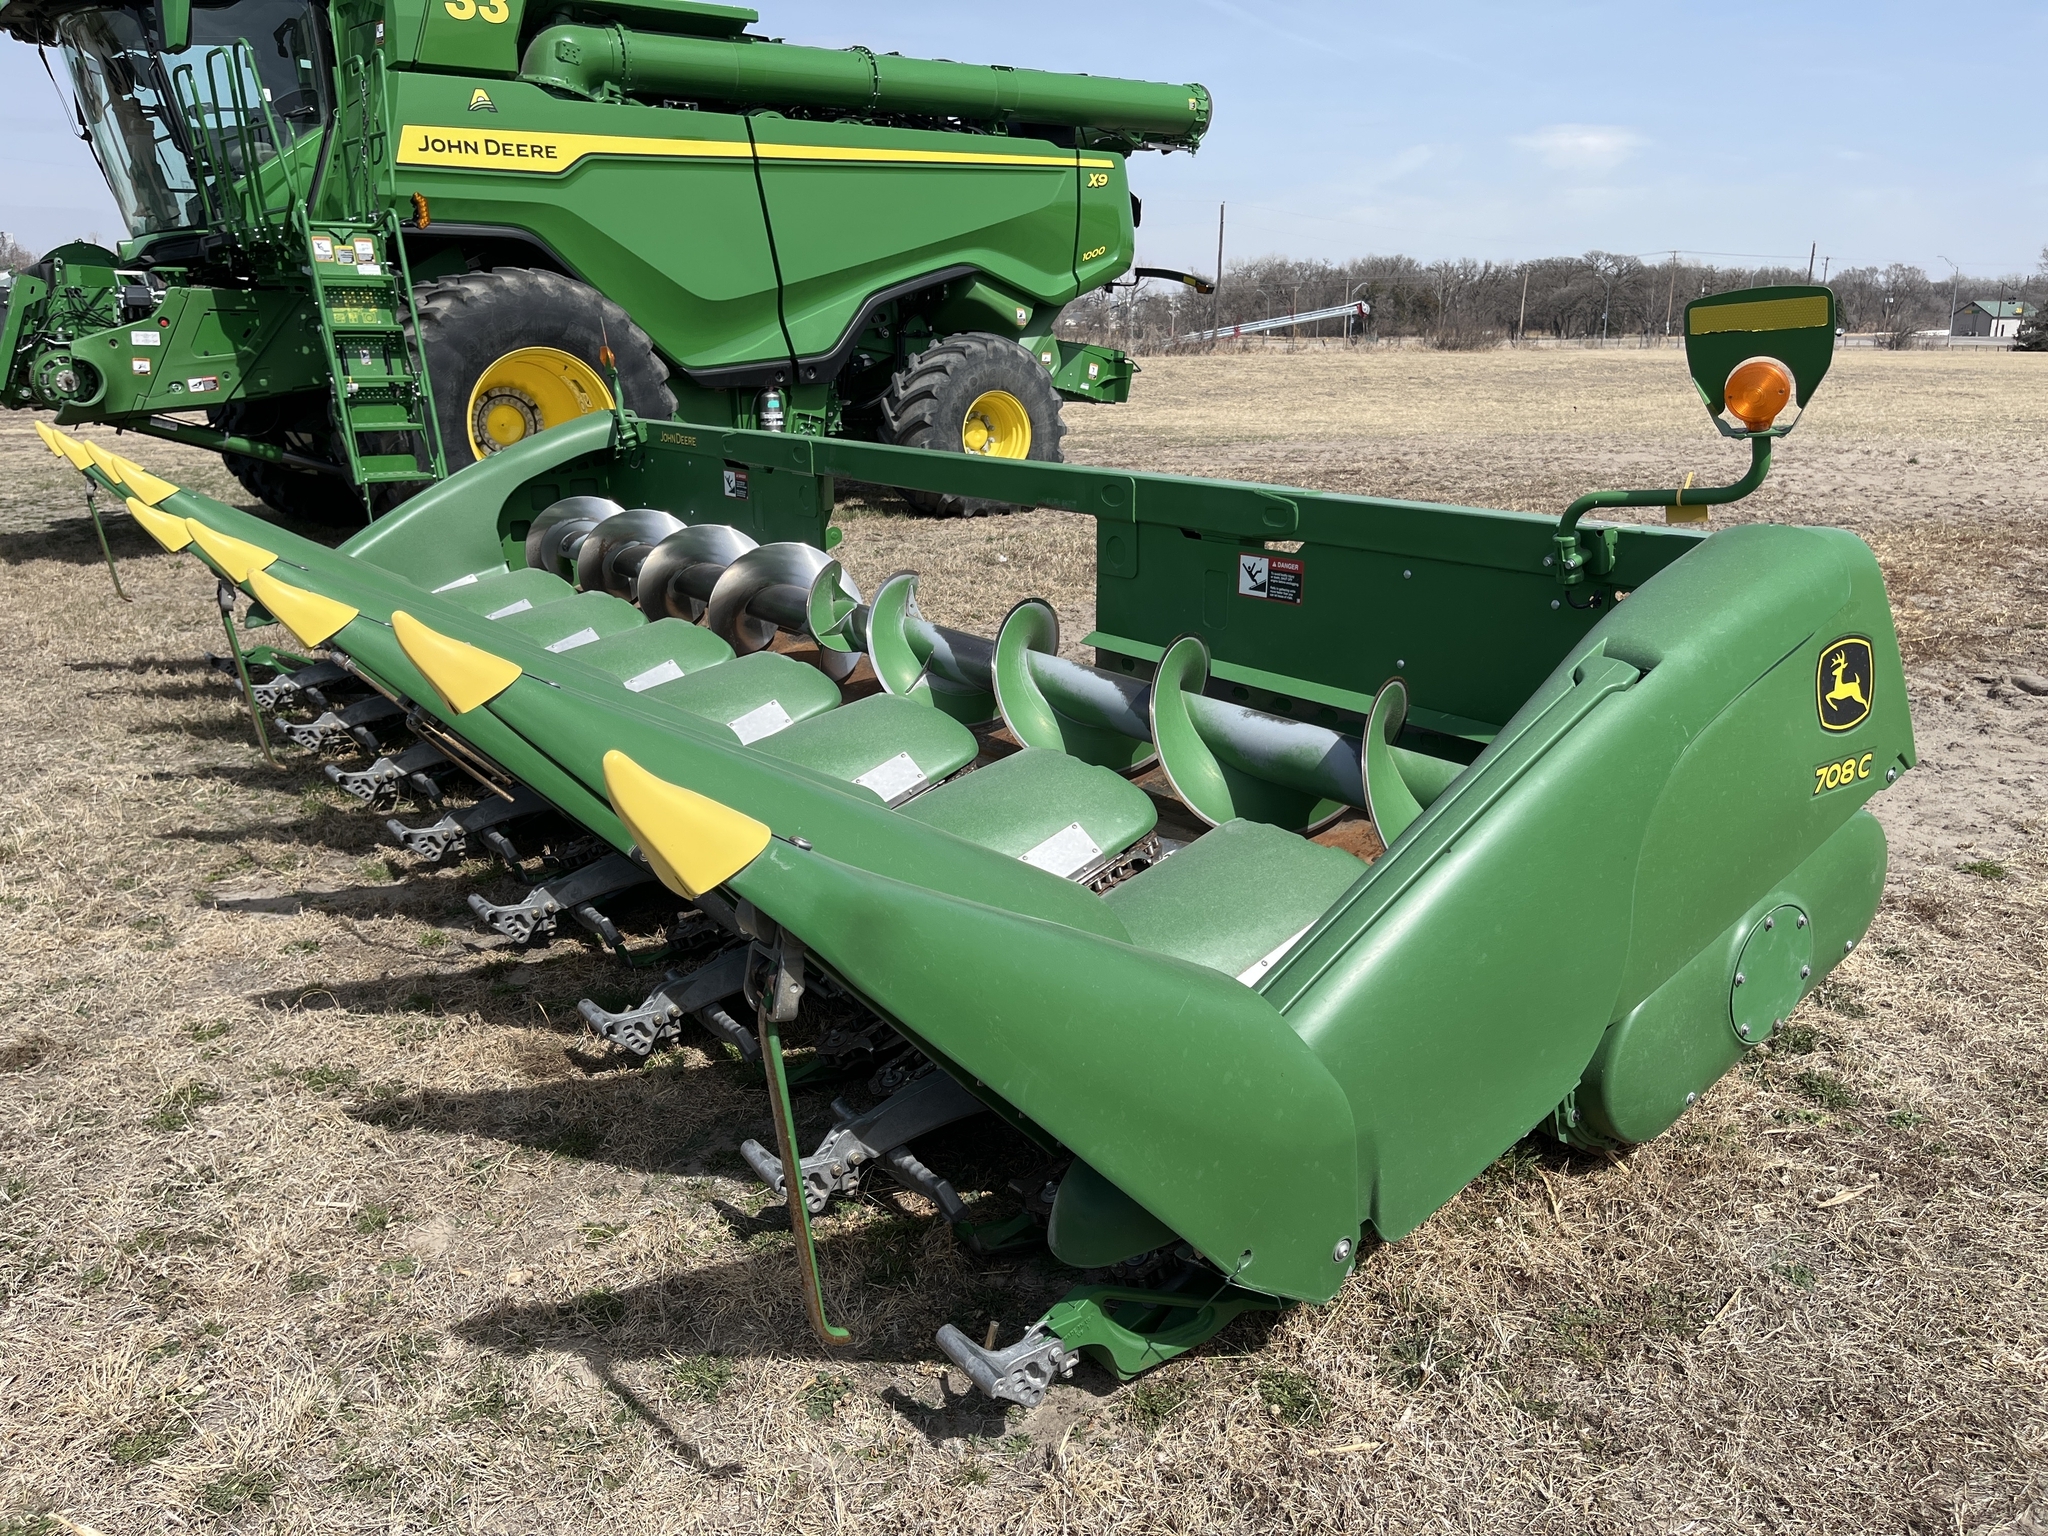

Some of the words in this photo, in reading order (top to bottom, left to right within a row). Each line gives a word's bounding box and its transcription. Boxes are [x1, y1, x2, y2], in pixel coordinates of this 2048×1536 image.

[418, 135, 479, 155] JOHN
[484, 138, 558, 159] DEERE
[1087, 173, 1109, 188] X9
[1082, 246, 1106, 262] 1000
[1277, 561, 1299, 571] DANGER
